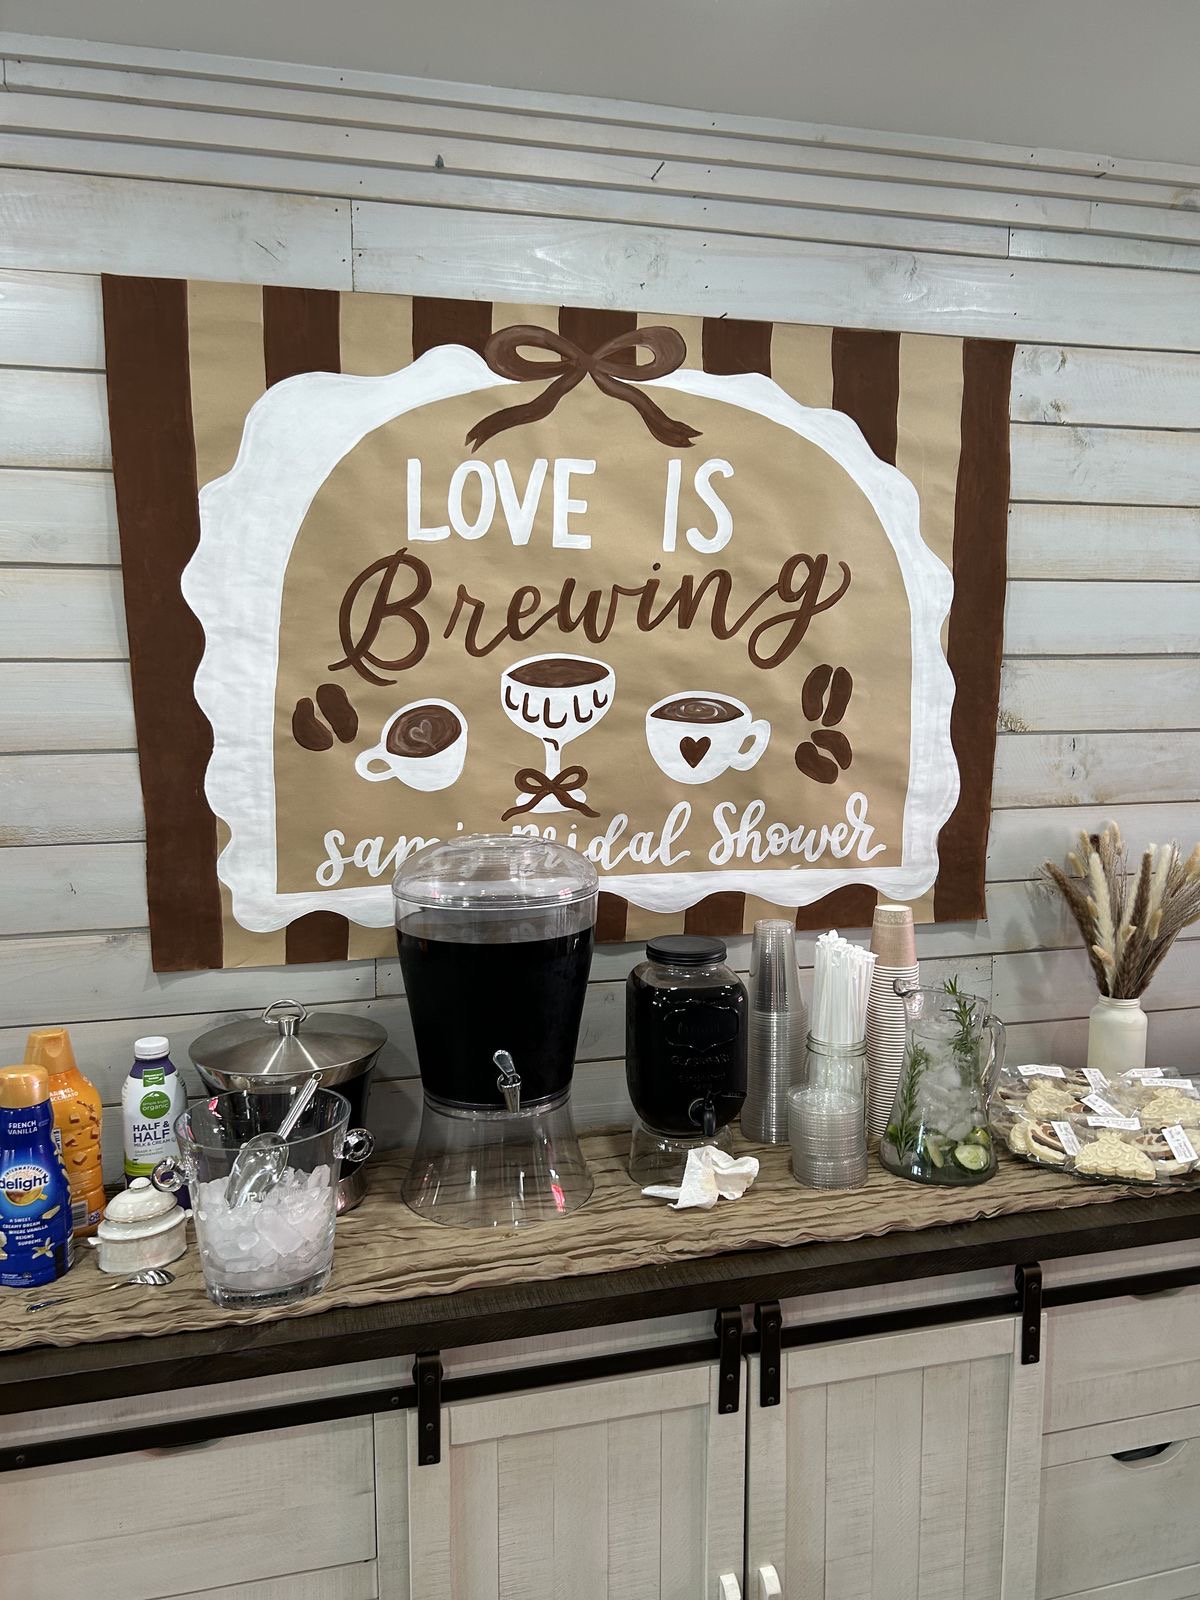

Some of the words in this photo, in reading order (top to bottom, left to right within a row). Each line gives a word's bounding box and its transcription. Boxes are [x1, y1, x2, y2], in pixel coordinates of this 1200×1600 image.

[407, 457, 597, 550] LOVE
[662, 457, 735, 554] IS
[327, 546, 853, 687] Brewing
[315, 821, 480, 887] Sam'
[707, 791, 888, 865] Shower
[49, 1087, 74, 1098] ARAMEL
[142, 1103, 169, 1112] organic
[8, 1120, 37, 1129] FRENCH
[133, 1122, 161, 1132] HALF
[163, 1120, 170, 1128] &
[7, 1127, 38, 1136] VANILLA
[133, 1128, 170, 1143] HALF
[151, 1138, 171, 1146] CREAM
[3, 1165, 46, 1177] INTERNATIONAL
[0, 1173, 49, 1192] delight
[27, 1224, 49, 1233] VANILLA
